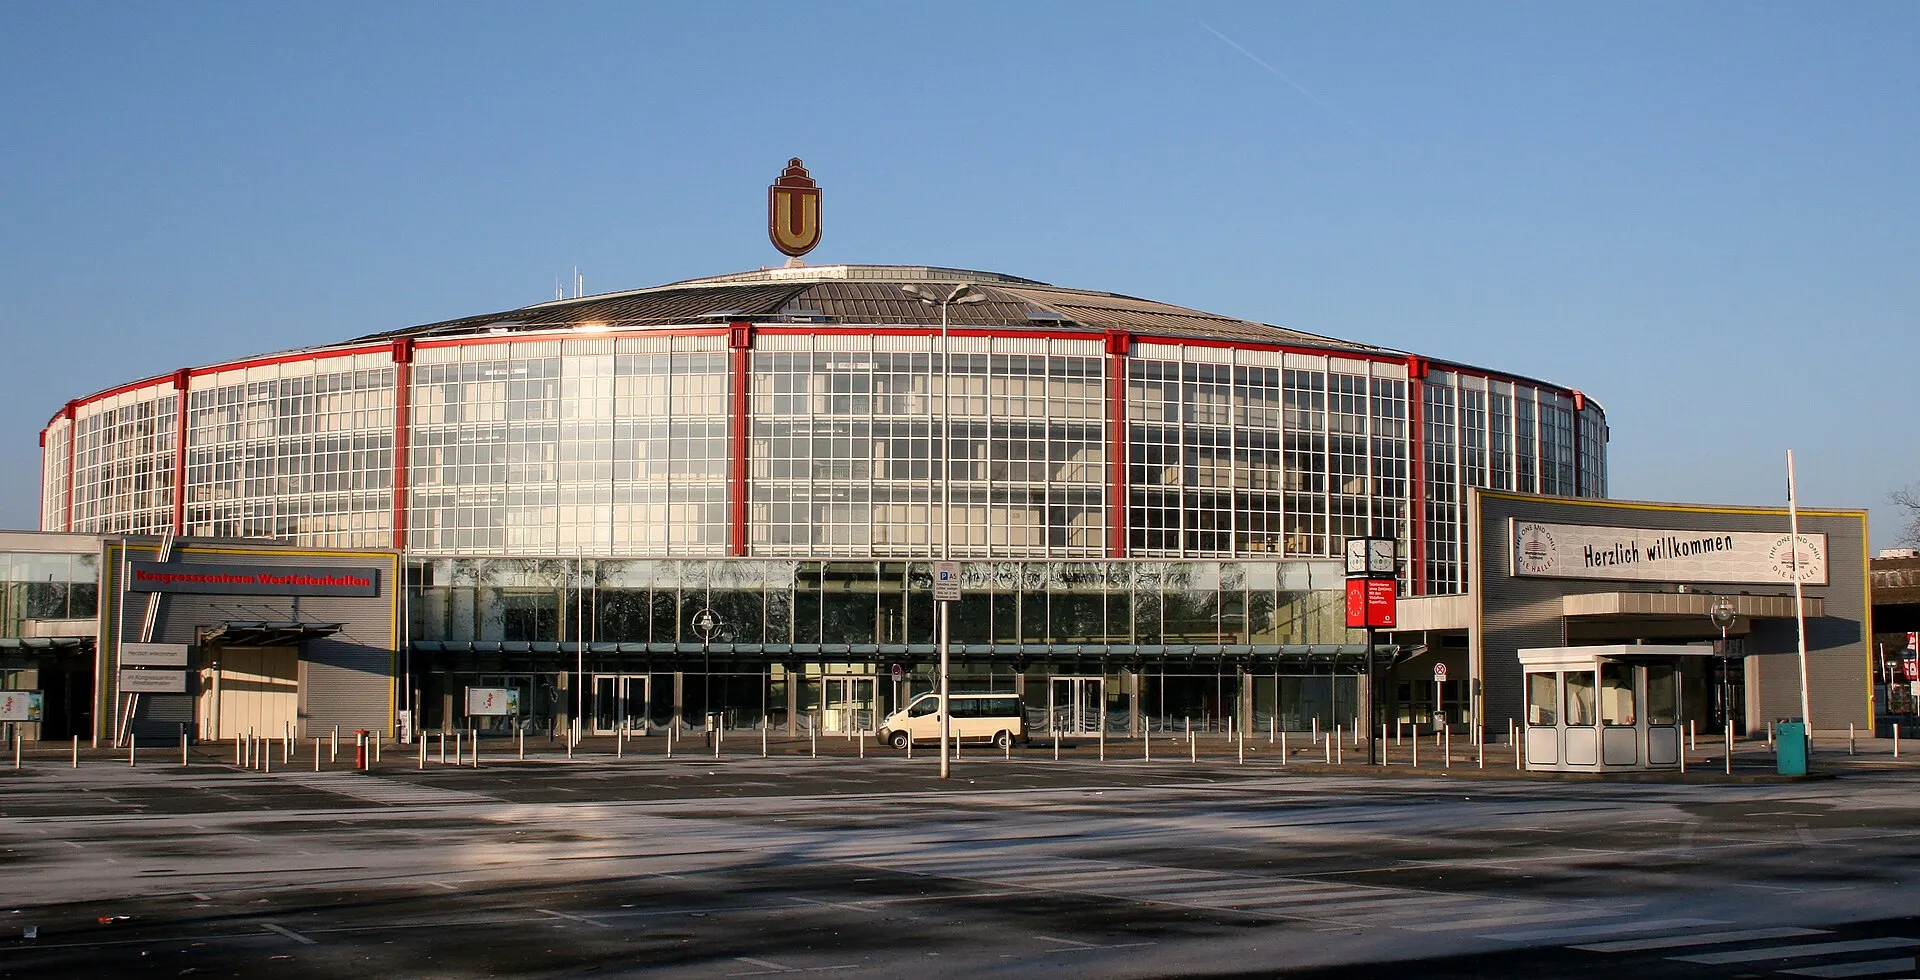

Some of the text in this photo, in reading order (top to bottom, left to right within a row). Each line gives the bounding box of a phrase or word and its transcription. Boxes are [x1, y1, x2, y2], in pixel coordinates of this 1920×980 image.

[777, 192, 817, 249] U
[1522, 525, 1533, 535] ONE
[1546, 533, 1556, 551] ONLY
[1769, 546, 1777, 559] THE
[1777, 536, 1791, 547] ONE
[1809, 543, 1821, 561] ONLY
[1519, 556, 1529, 569] DIE
[1584, 535, 1733, 568] Herzlich willkommen
[136, 570, 370, 587] Kongresszentrum Westfalenhallen
[1772, 565, 1786, 577] DIE
